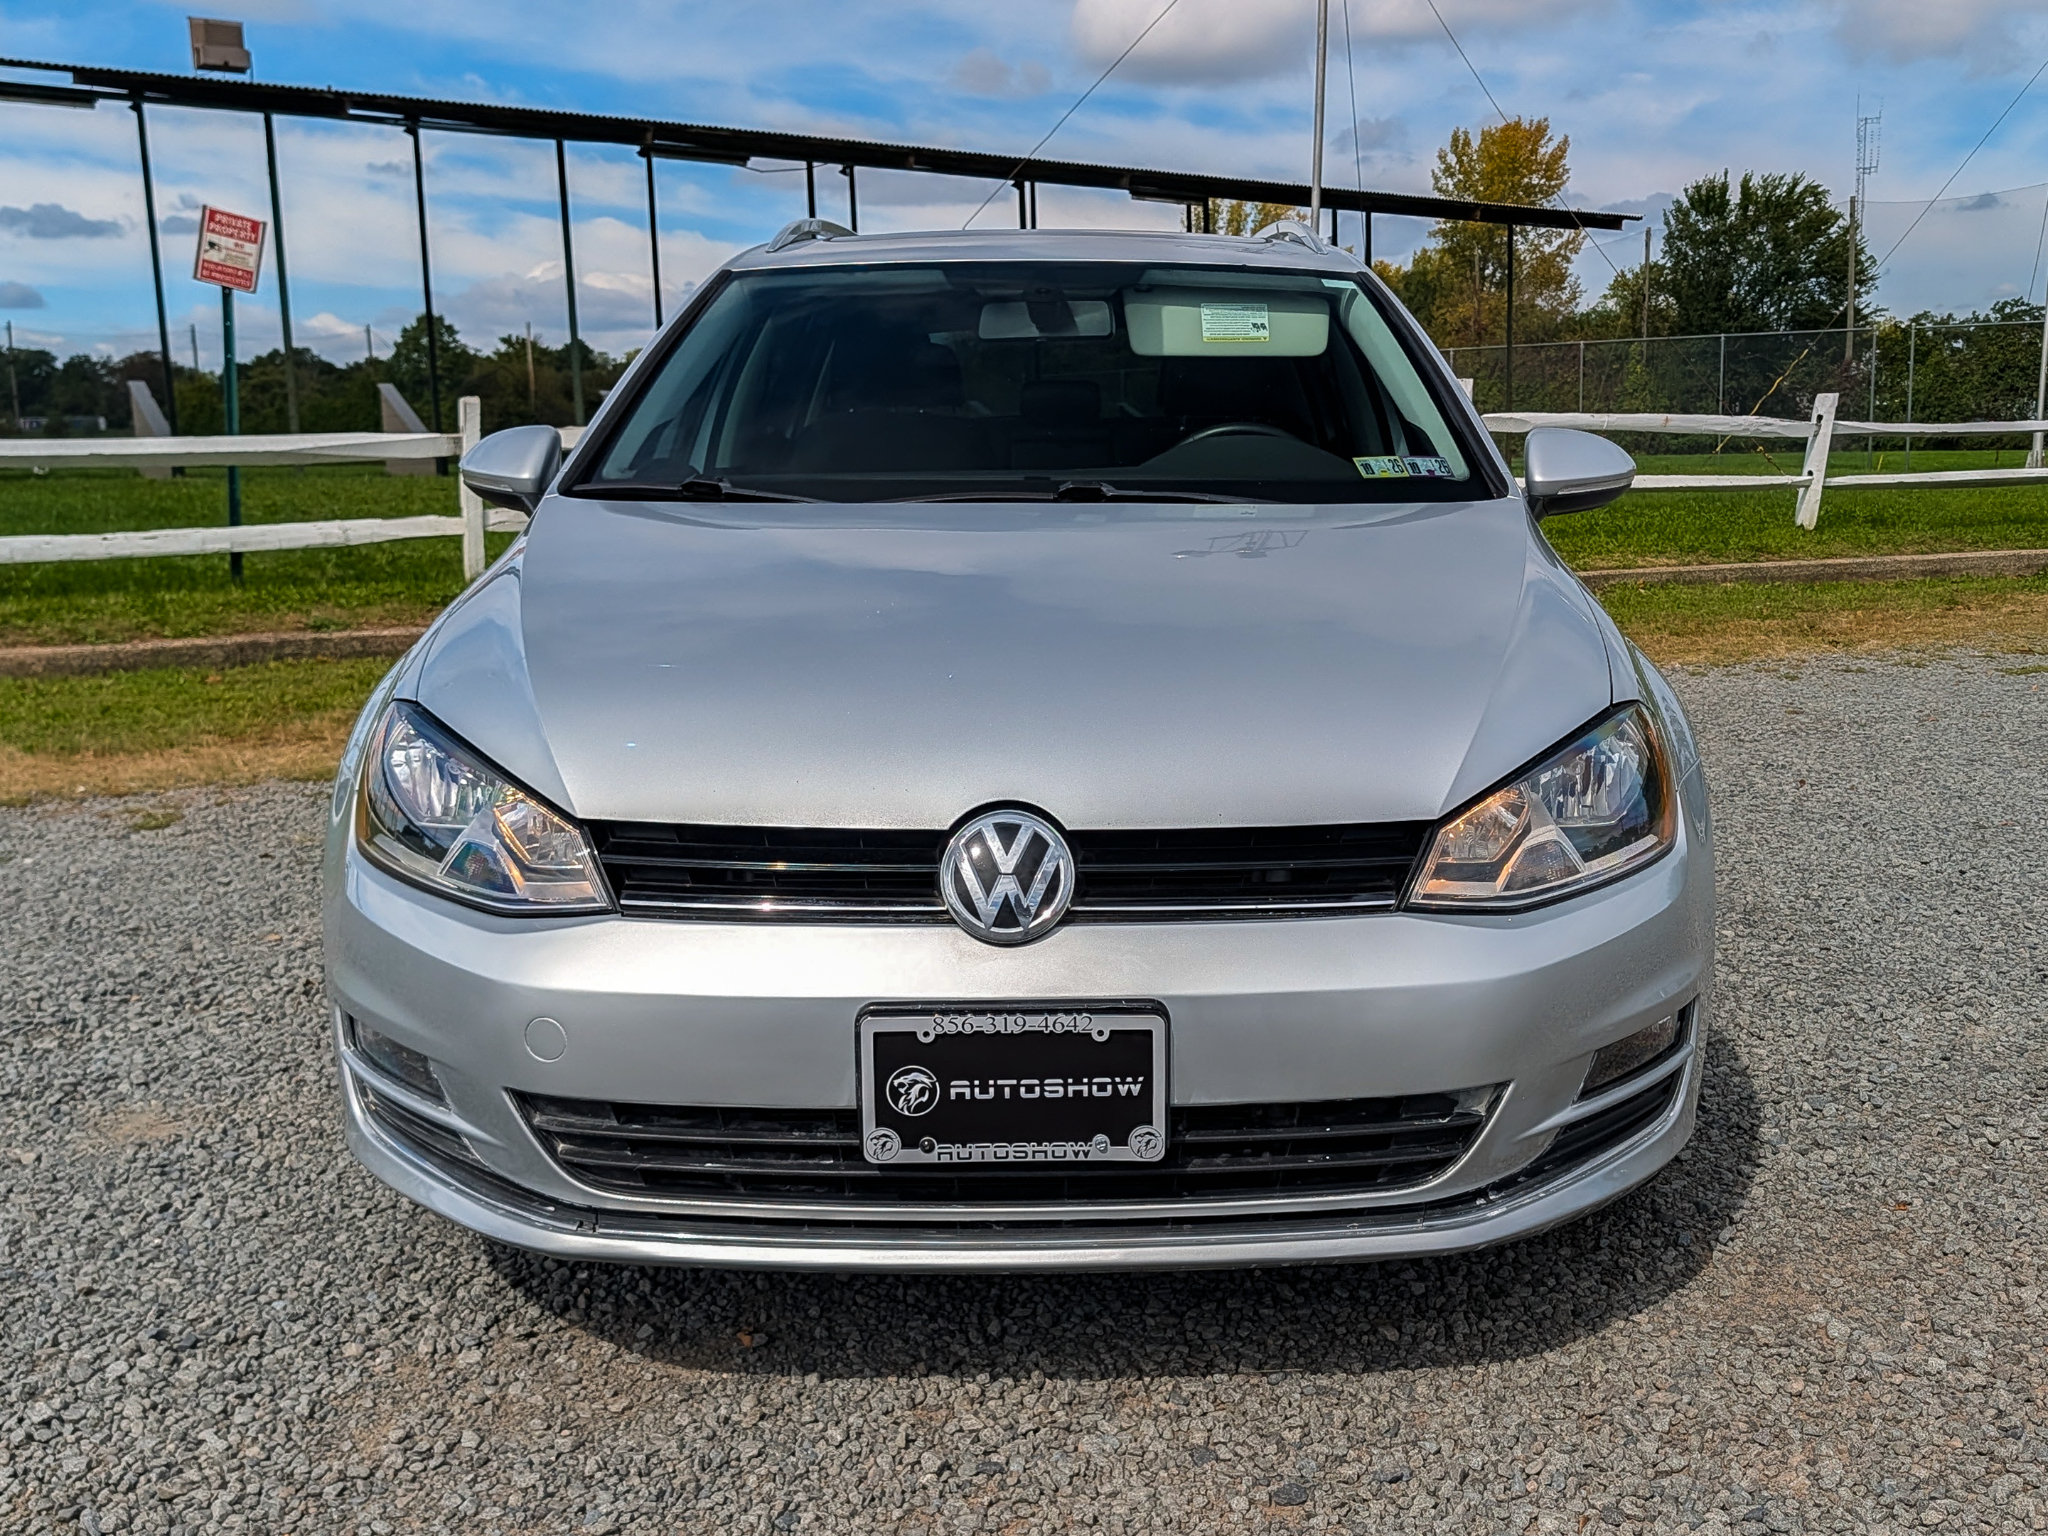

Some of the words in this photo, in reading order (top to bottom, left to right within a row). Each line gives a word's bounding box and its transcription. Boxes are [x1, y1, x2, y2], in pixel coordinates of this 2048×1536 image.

[208, 221, 256, 241] PROPERTY
[214, 212, 252, 231] PRIVATE
[1360, 462, 1375, 475] 10
[1388, 458, 1404, 474] 26
[1407, 461, 1421, 474] 10
[1435, 458, 1451, 474] 26
[932, 1016, 1094, 1034] 856-319-4642
[949, 1076, 1145, 1100] AUTOSHOW
[936, 1142, 1094, 1162] AUTOSHOW
